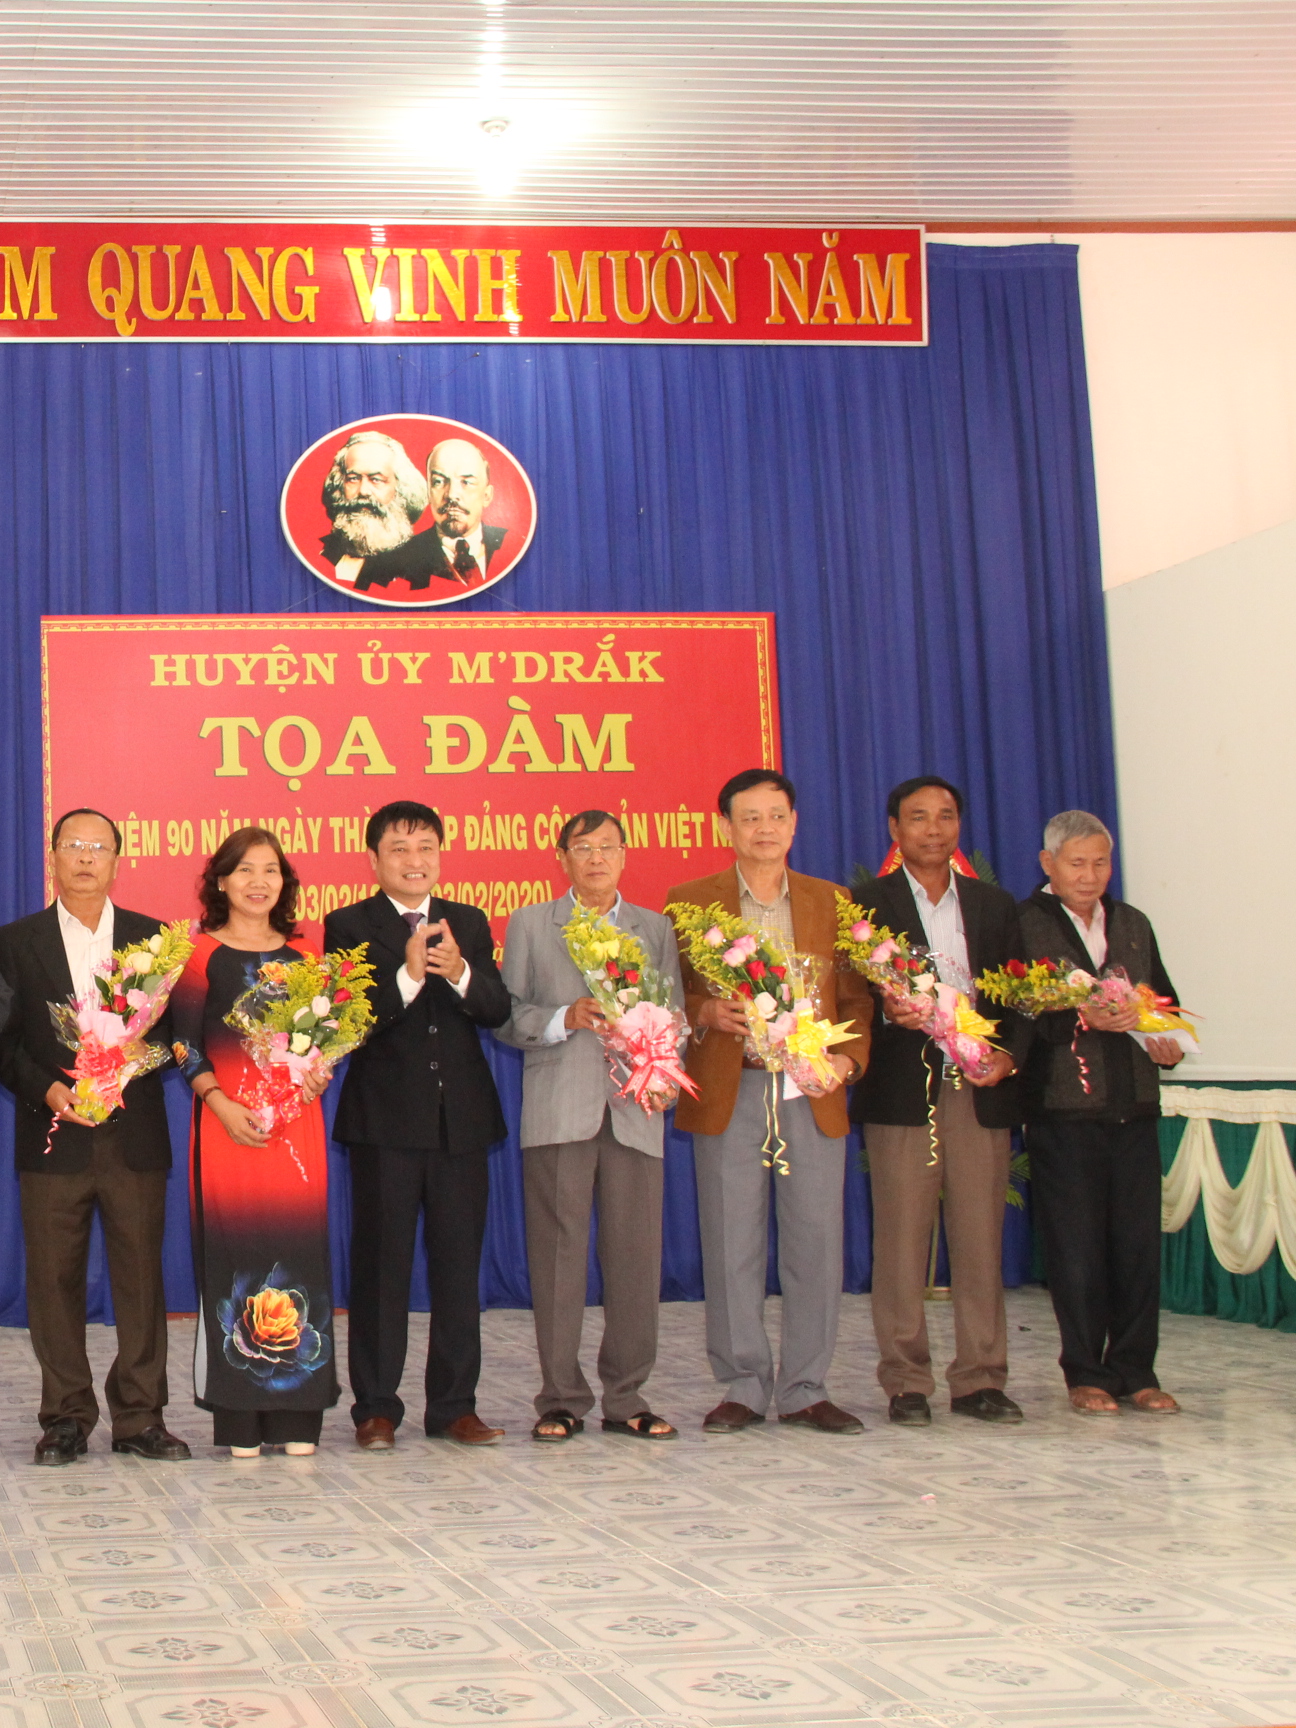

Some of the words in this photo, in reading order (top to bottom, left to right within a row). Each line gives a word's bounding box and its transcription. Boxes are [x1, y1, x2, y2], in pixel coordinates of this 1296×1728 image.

[86, 242, 321, 338] QUANG
[341, 247, 526, 324] VINH
[548, 228, 740, 326] MUÔN
[764, 230, 914, 328] NĂM
[150, 643, 339, 694] HUYỆN
[357, 640, 432, 685] ỦY
[448, 633, 664, 684] M'DRẮK
[198, 715, 397, 792] TỌA
[423, 695, 636, 775] ĐÀM
[113, 811, 160, 868] IỆM
[166, 819, 194, 857] 90
[464, 800, 527, 851] ĐẢNG
[607, 798, 649, 849] ẢN
[654, 803, 705, 859] VIỆT
